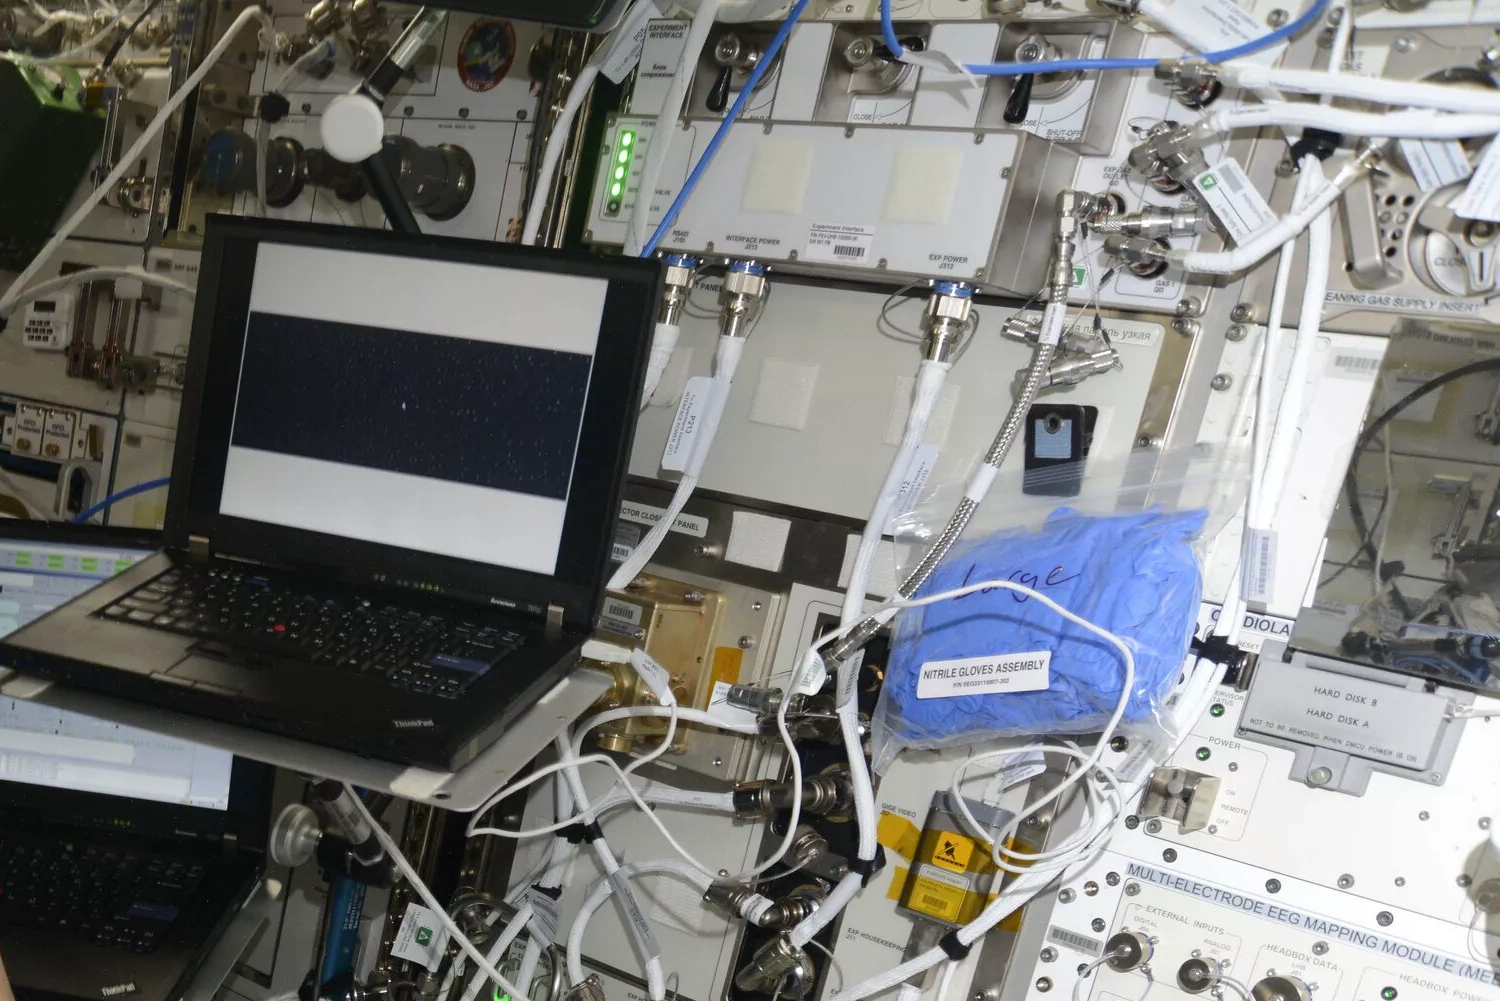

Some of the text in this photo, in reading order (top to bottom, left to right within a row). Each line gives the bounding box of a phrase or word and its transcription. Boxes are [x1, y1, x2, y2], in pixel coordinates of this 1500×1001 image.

[649, 24, 688, 32] EXPERIMENT
[649, 31, 684, 39] INTERFACE
[725, 235, 781, 246] INTERFACE POWER
[928, 253, 969, 264] EXP POWER
[1367, 295, 1480, 313] GAS SUPPLY INSERT
[1121, 329, 1152, 341] узкая
[678, 520, 700, 531] PANEL
[1238, 640, 1260, 650] RESET
[923, 660, 1045, 680] NITRILE GLOVES ASSEMBLY
[1313, 686, 1378, 707] HARD DISK B
[392, 719, 434, 728] ThinkPad
[1306, 708, 1369, 729] HARD DISK A
[1208, 736, 1241, 751] POWER
[1249, 717, 1263, 727] NOT
[1265, 721, 1274, 729] TO
[1288, 727, 1320, 740] REMOVED
[1323, 734, 1343, 745] WHEN
[1368, 744, 1393, 757] POWER
[1396, 752, 1403, 760] IS
[1407, 754, 1417, 762] ON
[1225, 789, 1236, 797] ON
[881, 803, 916, 818] GIGE VIDEO
[1220, 803, 1249, 816] REMOTE
[1216, 818, 1229, 826] OFF
[1127, 863, 1455, 973] MULTI-ELECTRODE EEG MAPPING MODULE
[1134, 916, 1159, 928] DIGITAL
[1146, 906, 1225, 936] EXTERNAL INPUTS
[847, 927, 860, 935] EXP
[1203, 939, 1232, 951] ANALOG
[1266, 944, 1339, 972] HEADBOX DATA
[100, 982, 136, 997] ThinkPad
[1399, 973, 1448, 994] HEADBOX
